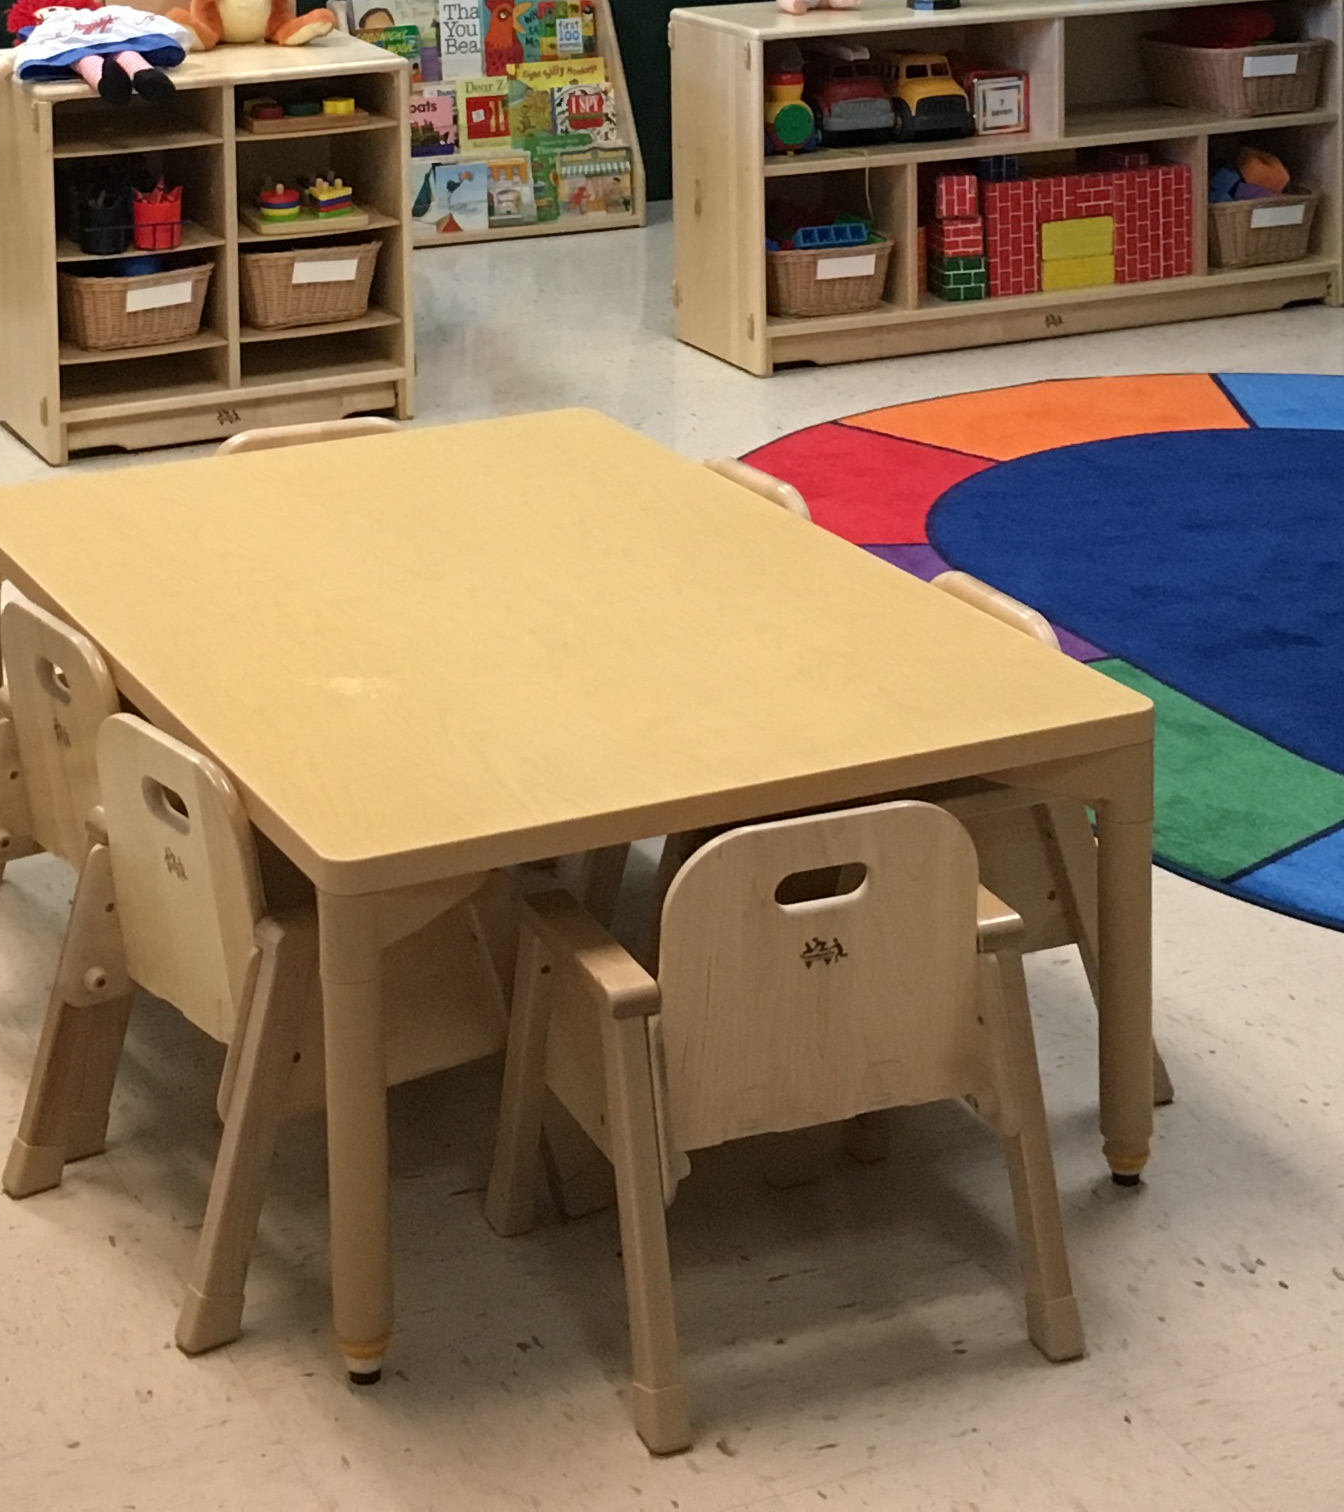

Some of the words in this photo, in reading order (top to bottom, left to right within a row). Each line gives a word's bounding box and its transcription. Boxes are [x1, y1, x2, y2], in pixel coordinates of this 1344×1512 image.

[444, 4, 479, 20] Tha
[444, 21, 478, 37] You
[558, 20, 580, 31] first
[558, 30, 580, 41] 100
[445, 39, 481, 55] Bea
[465, 81, 493, 94] Dear
[410, 101, 438, 113] oats
[579, 94, 599, 113] SPY
